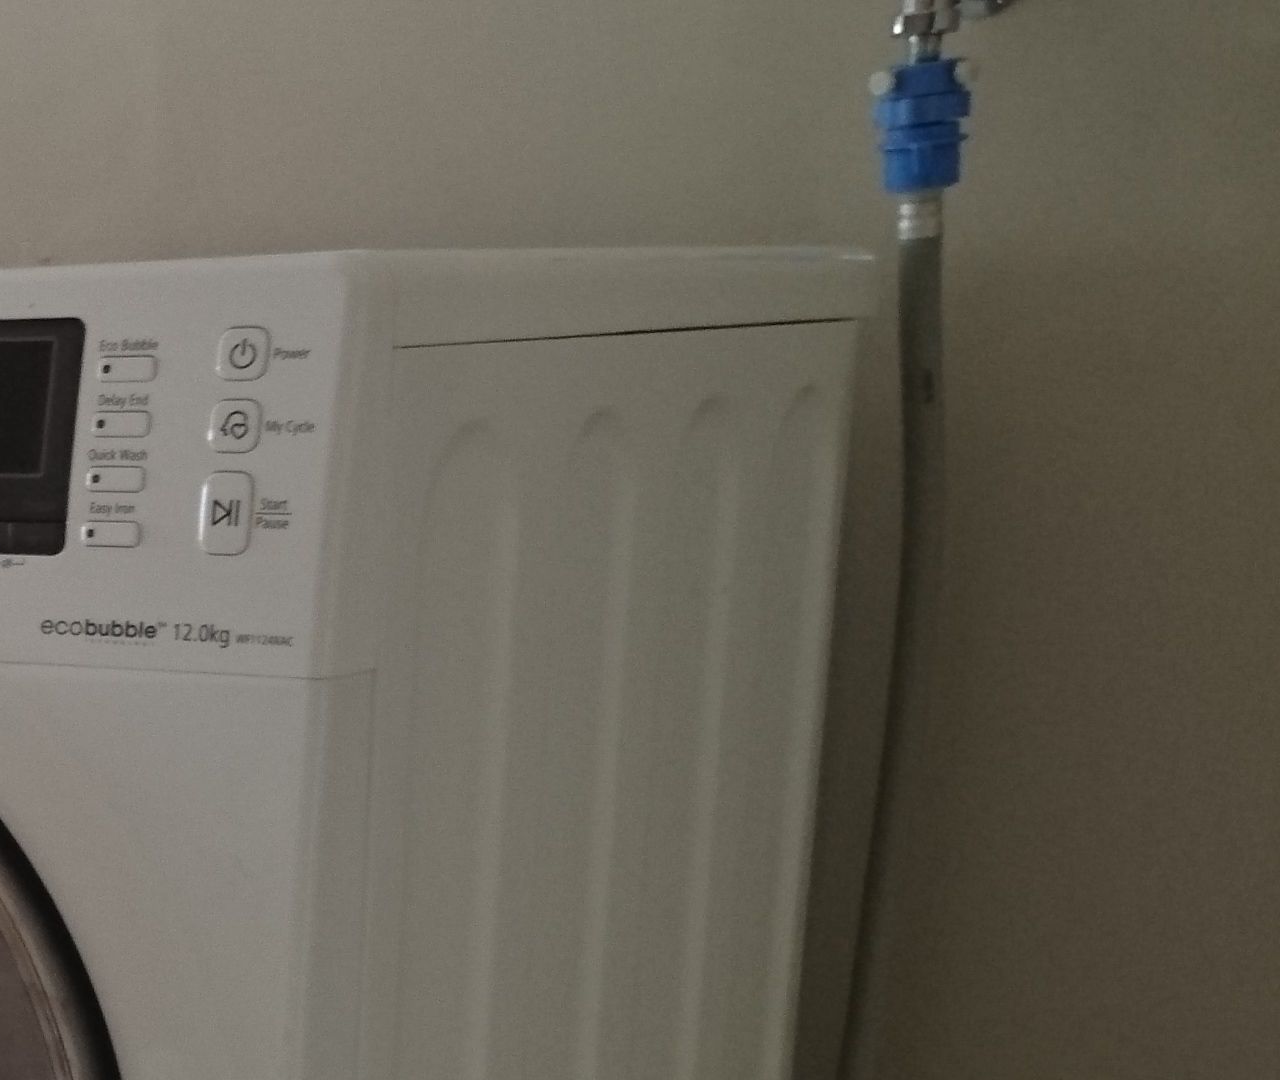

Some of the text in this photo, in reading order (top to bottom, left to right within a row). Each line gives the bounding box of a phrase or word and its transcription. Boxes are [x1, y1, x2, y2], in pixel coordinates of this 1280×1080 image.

[99, 338, 159, 351] Eco Bubble
[273, 347, 312, 360] Power
[97, 393, 149, 409] Delay End
[265, 419, 316, 436] My Cycle
[87, 449, 148, 461] Quick Wash
[90, 502, 135, 516] Easy Iron
[259, 498, 287, 511] Start
[256, 516, 288, 530] Pause
[173, 623, 231, 648] 12.0kg
